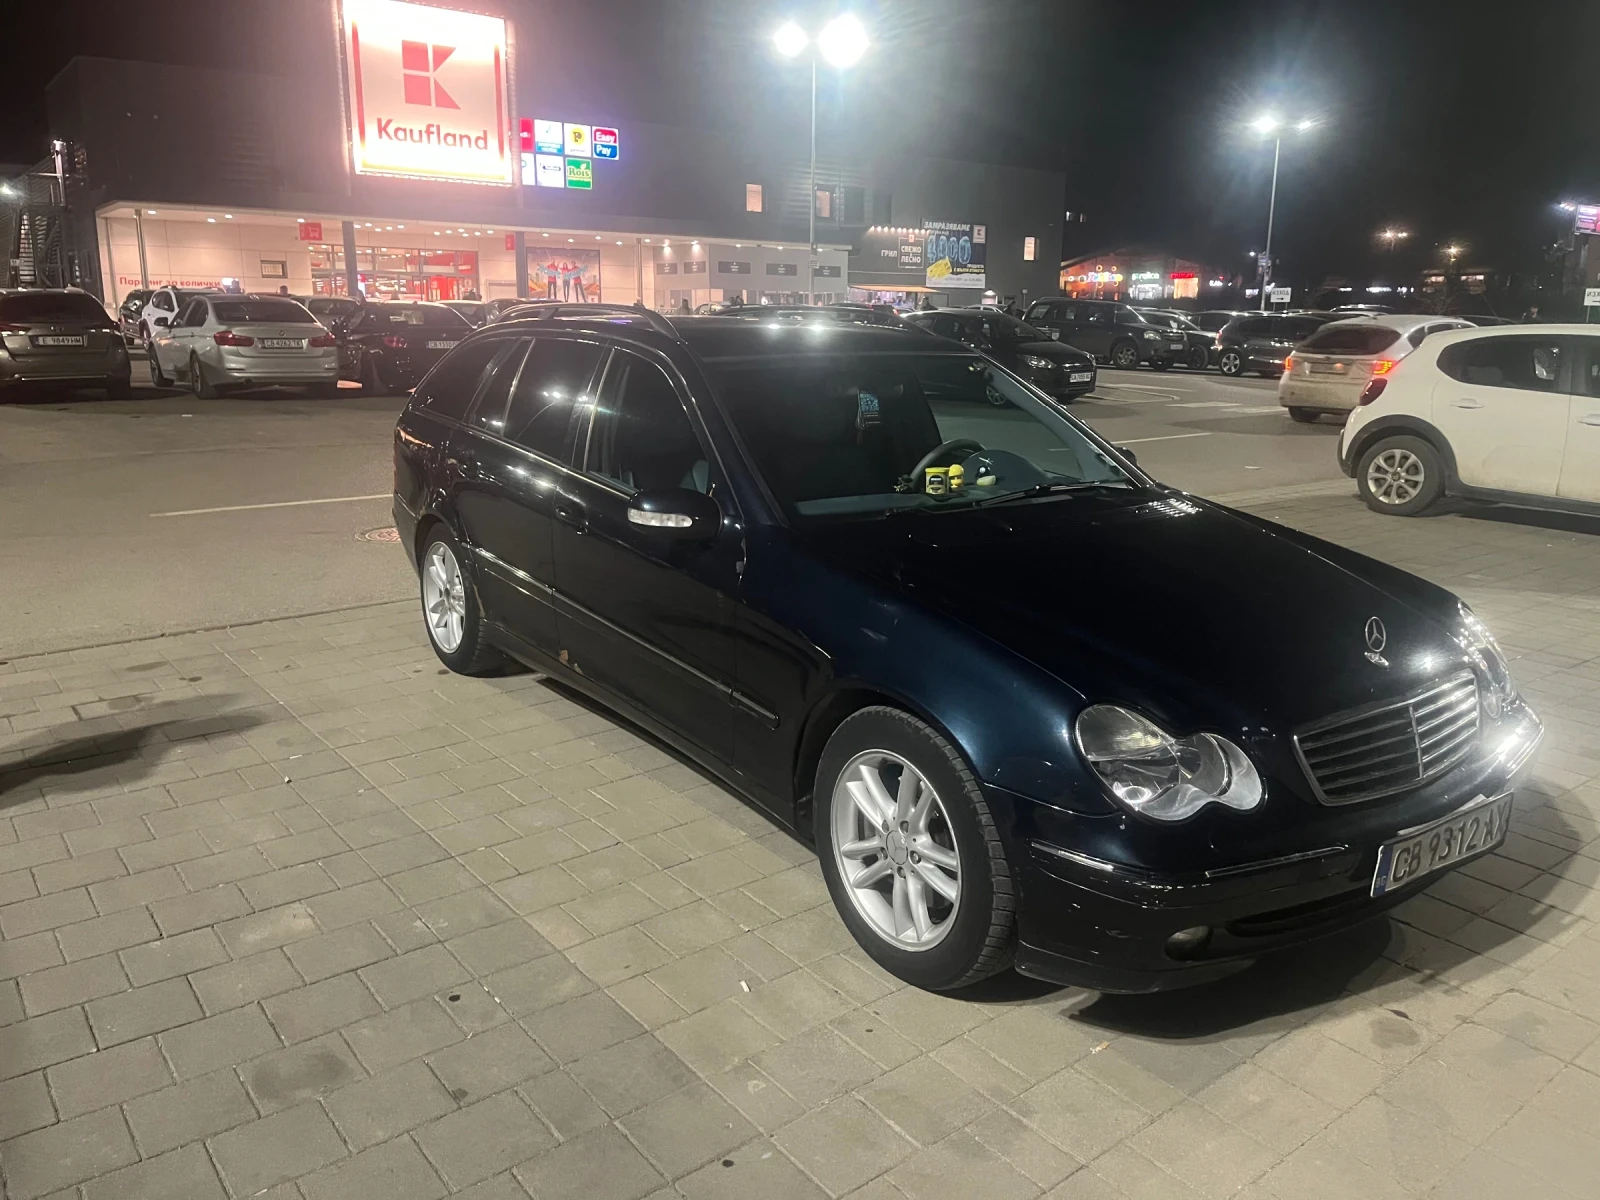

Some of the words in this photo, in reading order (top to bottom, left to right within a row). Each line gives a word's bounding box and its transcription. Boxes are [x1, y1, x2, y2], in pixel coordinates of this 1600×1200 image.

[377, 117, 488, 150] Kaufland
[596, 131, 615, 142] Easy
[596, 145, 611, 156] Pay
[569, 166, 590, 177] Rois
[924, 221, 971, 231] ЗАМРАЗЯВАМЕ
[901, 255, 921, 263] ЛЕСНО
[180, 280, 221, 288] колички
[1390, 840, 1422, 883] CB
[1428, 816, 1481, 868] 9312
[1375, 875, 1387, 889] BG
